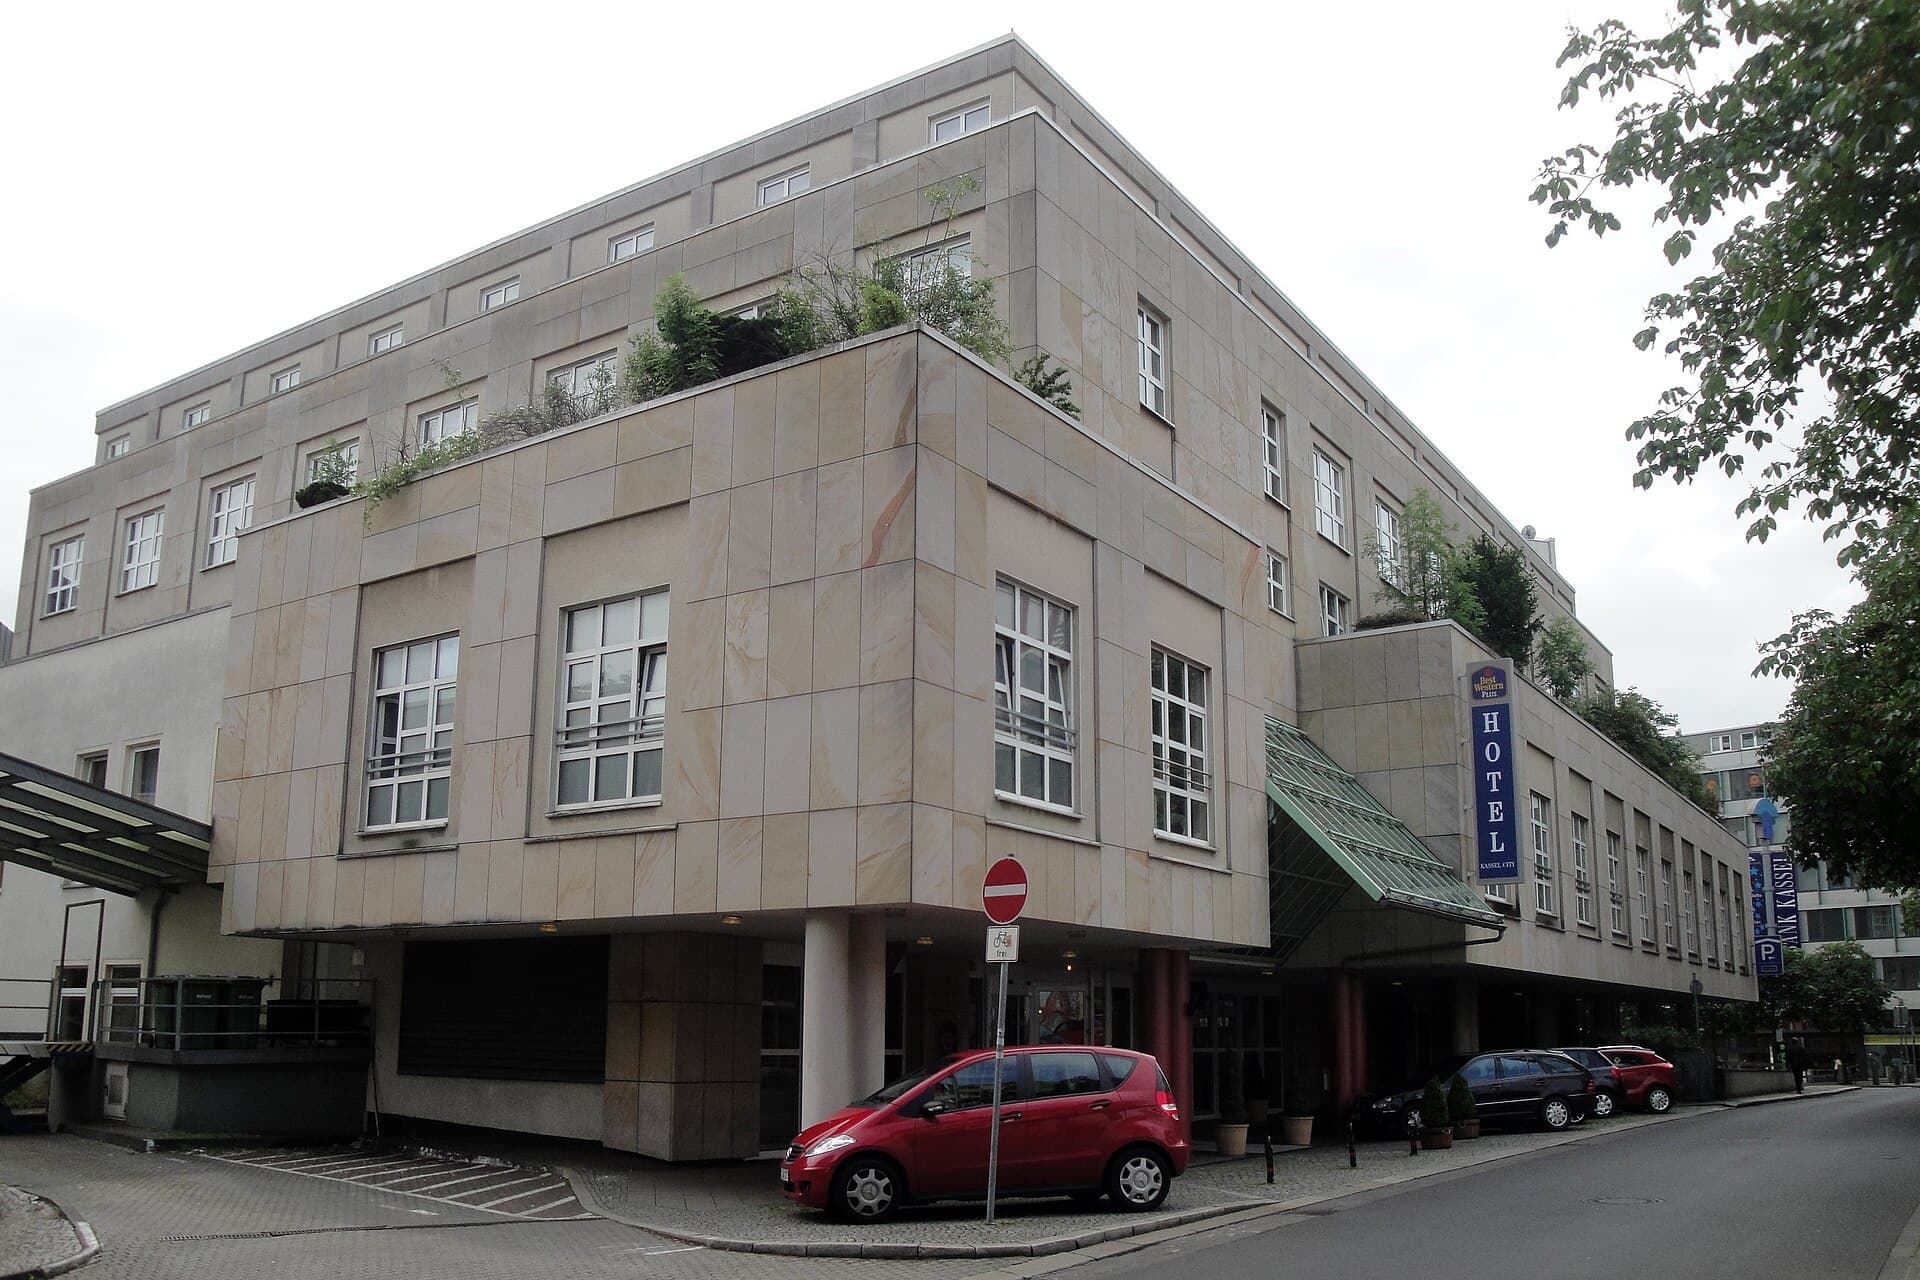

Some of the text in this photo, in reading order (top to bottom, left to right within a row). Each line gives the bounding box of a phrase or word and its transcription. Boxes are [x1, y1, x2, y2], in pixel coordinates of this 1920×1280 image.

[1480, 675, 1496, 684] Best
[1473, 682, 1503, 692] Western
[1482, 711, 1505, 853] HOTEL
[996, 950, 1007, 958] frei
[1760, 943, 1775, 961] P
